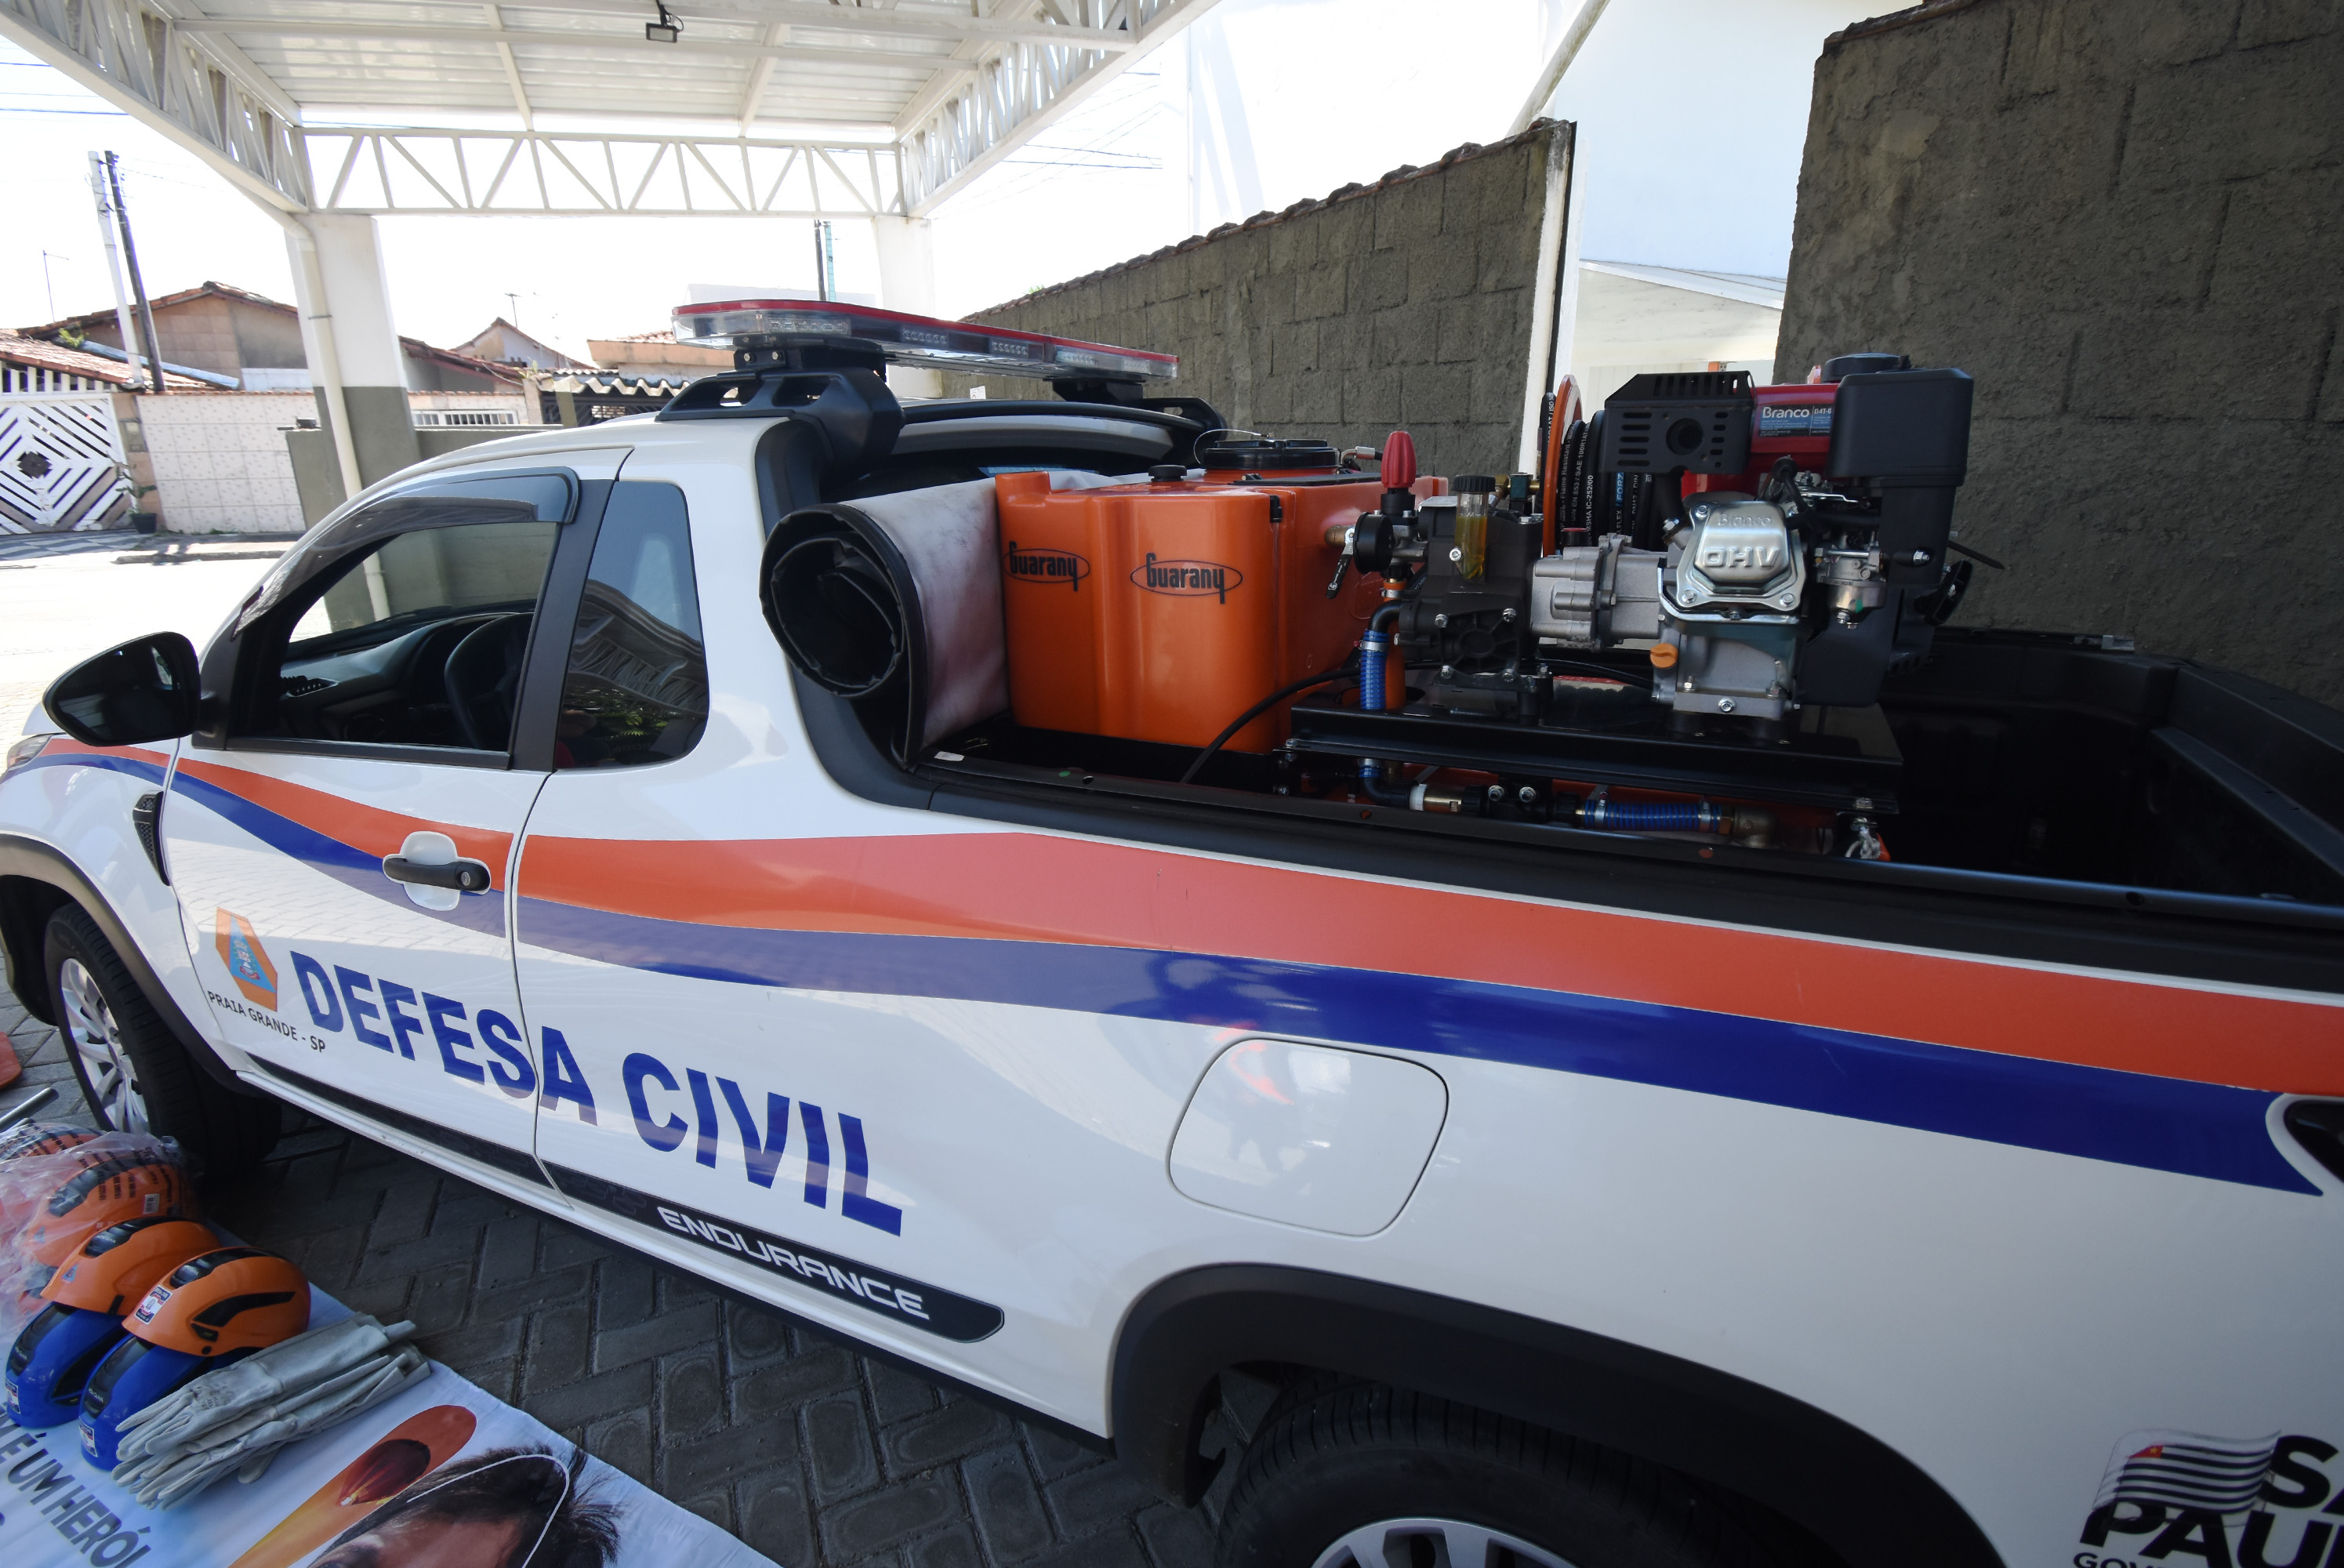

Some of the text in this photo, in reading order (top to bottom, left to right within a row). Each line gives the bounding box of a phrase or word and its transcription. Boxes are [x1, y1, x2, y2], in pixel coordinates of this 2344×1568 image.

[1762, 406, 1810, 419] Branco
[1562, 444, 1570, 475] Resistant
[1572, 497, 1578, 507] EN
[1718, 514, 1771, 526] Branco
[1009, 541, 1078, 592] Guarany
[1146, 553, 1225, 604] Guarany
[1703, 546, 1779, 567] OHV
[207, 990, 247, 1017] PRAIA
[248, 1007, 298, 1041] GRANDE
[310, 1035, 325, 1053] SP
[290, 950, 902, 1236] DEFESA CIVIL
[657, 1207, 931, 1320] ENDURANCE
[8, 1448, 76, 1506] UM
[2256, 1435, 2344, 1515] S
[40, 1484, 152, 1568] HERÓI
[2079, 1497, 2344, 1568] PAU
